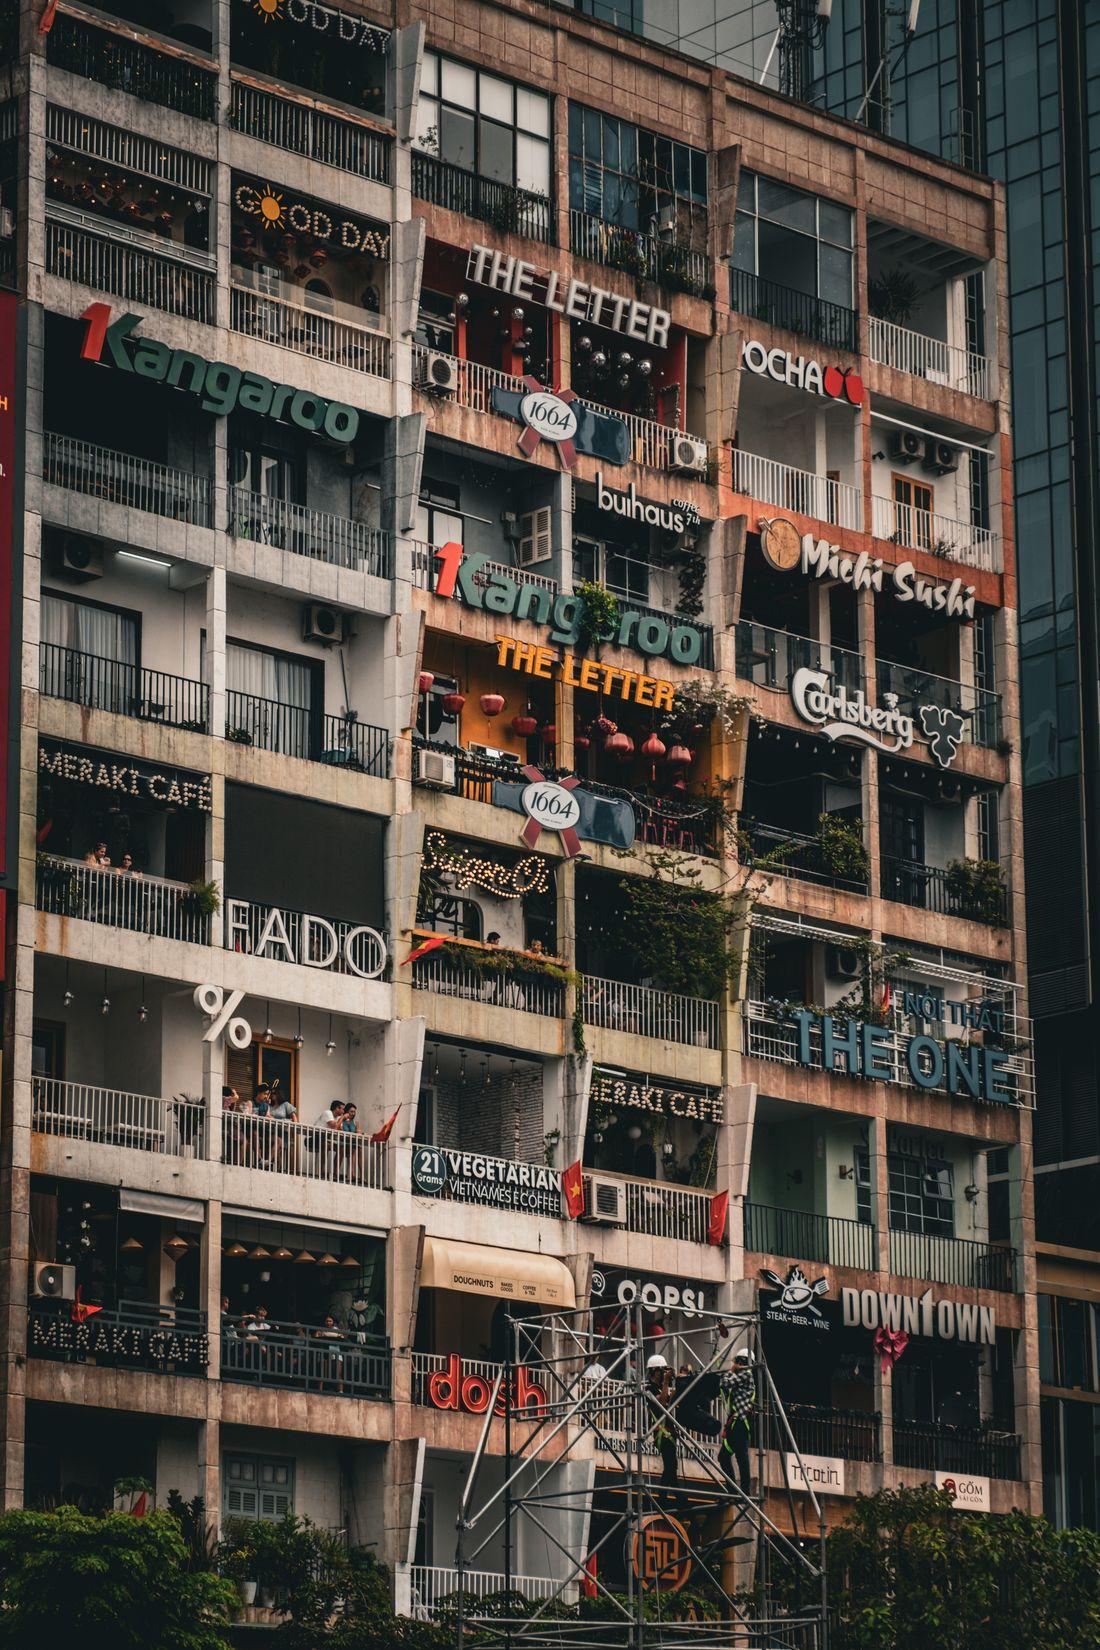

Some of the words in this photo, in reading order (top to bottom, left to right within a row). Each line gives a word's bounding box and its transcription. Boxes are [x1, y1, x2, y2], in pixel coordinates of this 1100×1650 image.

[339, 17, 391, 54] DAY
[341, 221, 390, 259] DAY
[471, 243, 536, 300] THE
[545, 270, 671, 349] LETTER
[529, 401, 574, 430] 1664
[801, 533, 884, 592] Michi
[892, 562, 976, 618] Sushi
[435, 541, 701, 664] Kangroo
[495, 633, 553, 680] THE
[562, 655, 675, 711] LETTER
[792, 667, 914, 748] Carlsberg
[39, 748, 140, 796] MERAKI
[530, 791, 577, 819] 1664
[226, 898, 388, 979] FADO
[796, 1010, 892, 1081] THE
[907, 1035, 1011, 1104] ONE
[416, 1172, 443, 1185] Grams
[420, 1151, 439, 1175] 21
[449, 1154, 562, 1193] VEGETARIAN
[453, 1275, 494, 1289] DOUGHNUTS
[617, 1279, 704, 1319] OOPS!
[32, 1319, 142, 1357] MERAKI
[766, 1311, 788, 1323] STEAK
[792, 1315, 808, 1326] BEER
[813, 1319, 831, 1331] WINE
